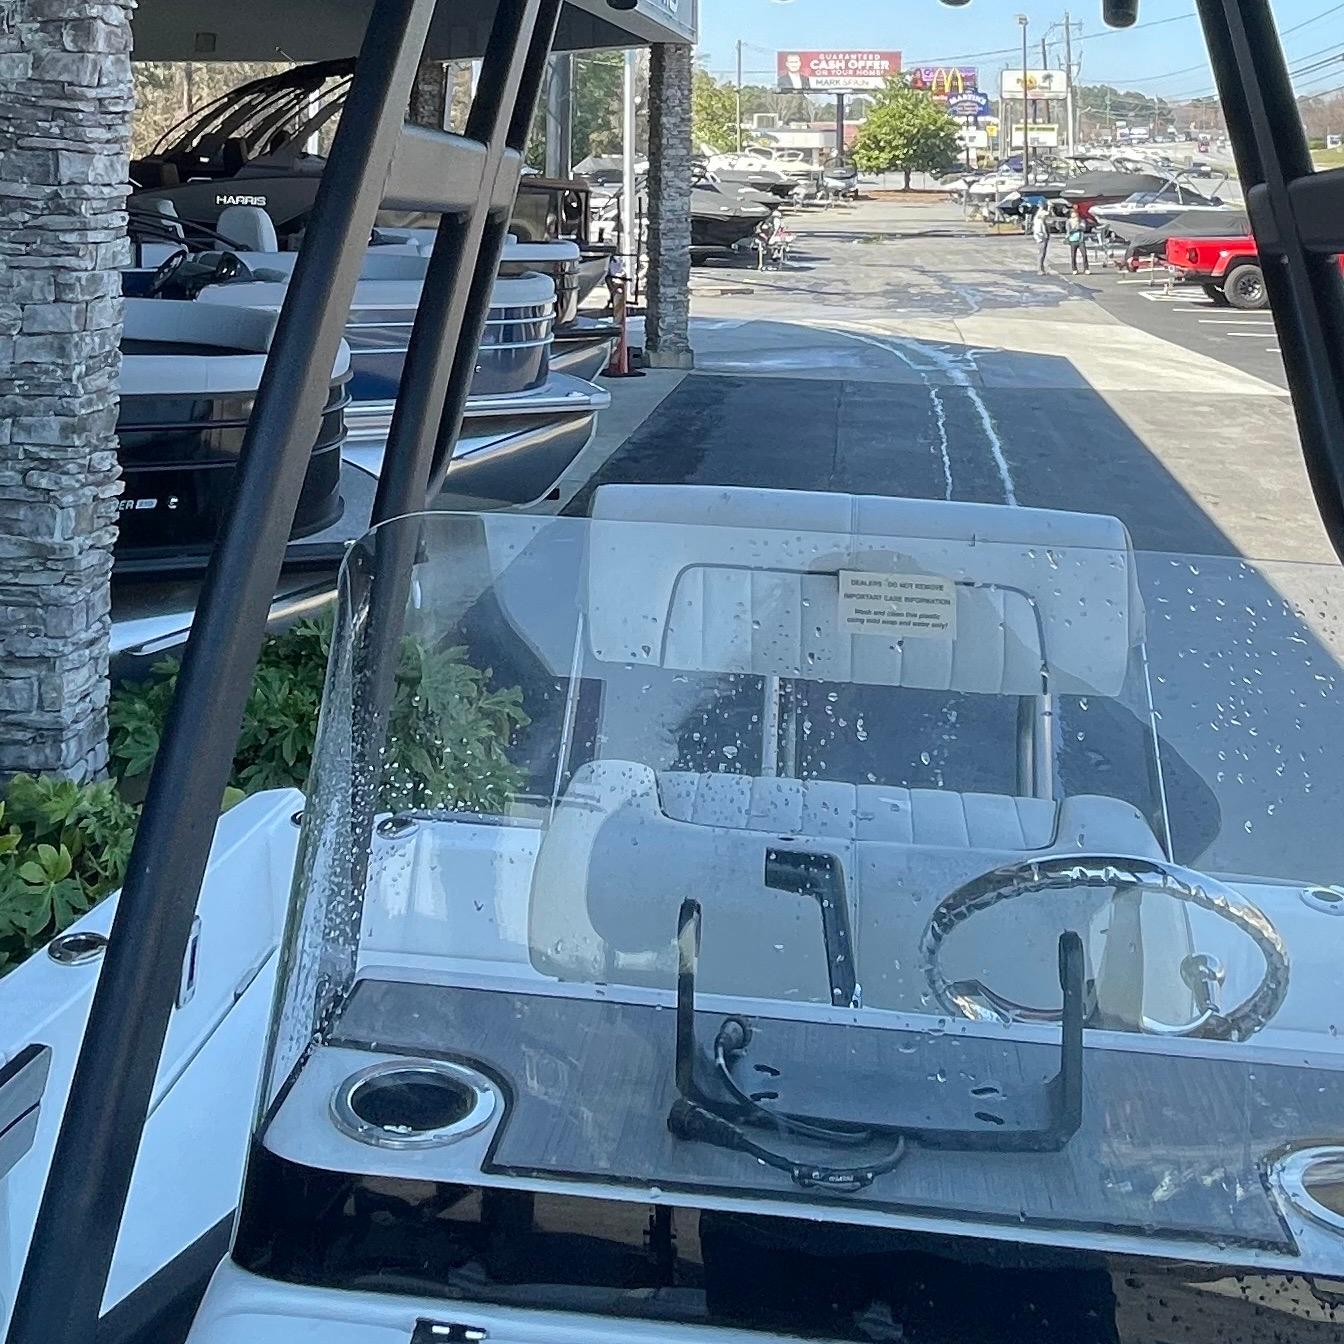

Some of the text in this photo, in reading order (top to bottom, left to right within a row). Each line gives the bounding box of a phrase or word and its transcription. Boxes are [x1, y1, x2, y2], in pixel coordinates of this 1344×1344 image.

[818, 53, 881, 61] GUARANTEED
[809, 59, 890, 70] CASH OFFER
[815, 79, 840, 87] MARK
[216, 195, 267, 206] HARRIS
[914, 583, 944, 591] REMOVE
[904, 597, 951, 605] INFORMATION
